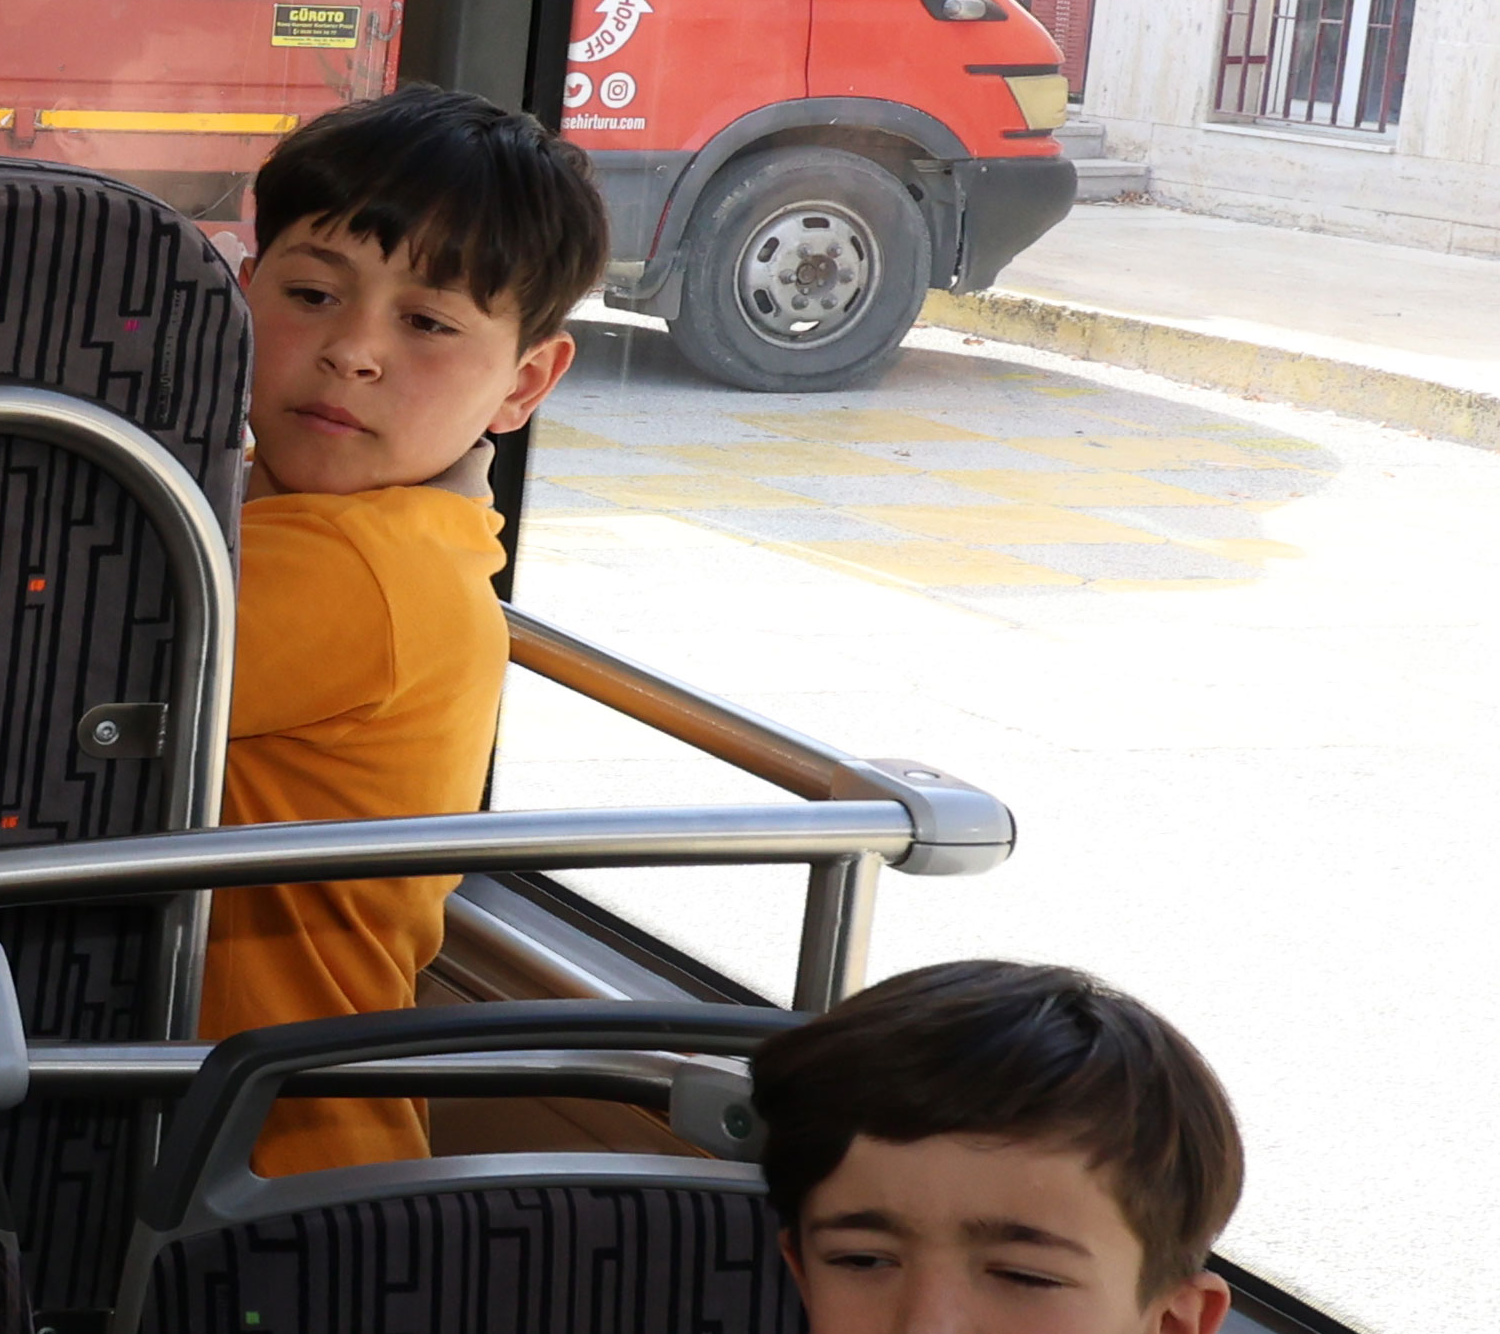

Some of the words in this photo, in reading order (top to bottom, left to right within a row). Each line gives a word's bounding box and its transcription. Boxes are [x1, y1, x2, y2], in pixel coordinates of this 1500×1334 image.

[289, 7, 345, 23] GÜROTO
[584, 29, 616, 60] OFF
[561, 114, 646, 130] sehirturu.com
